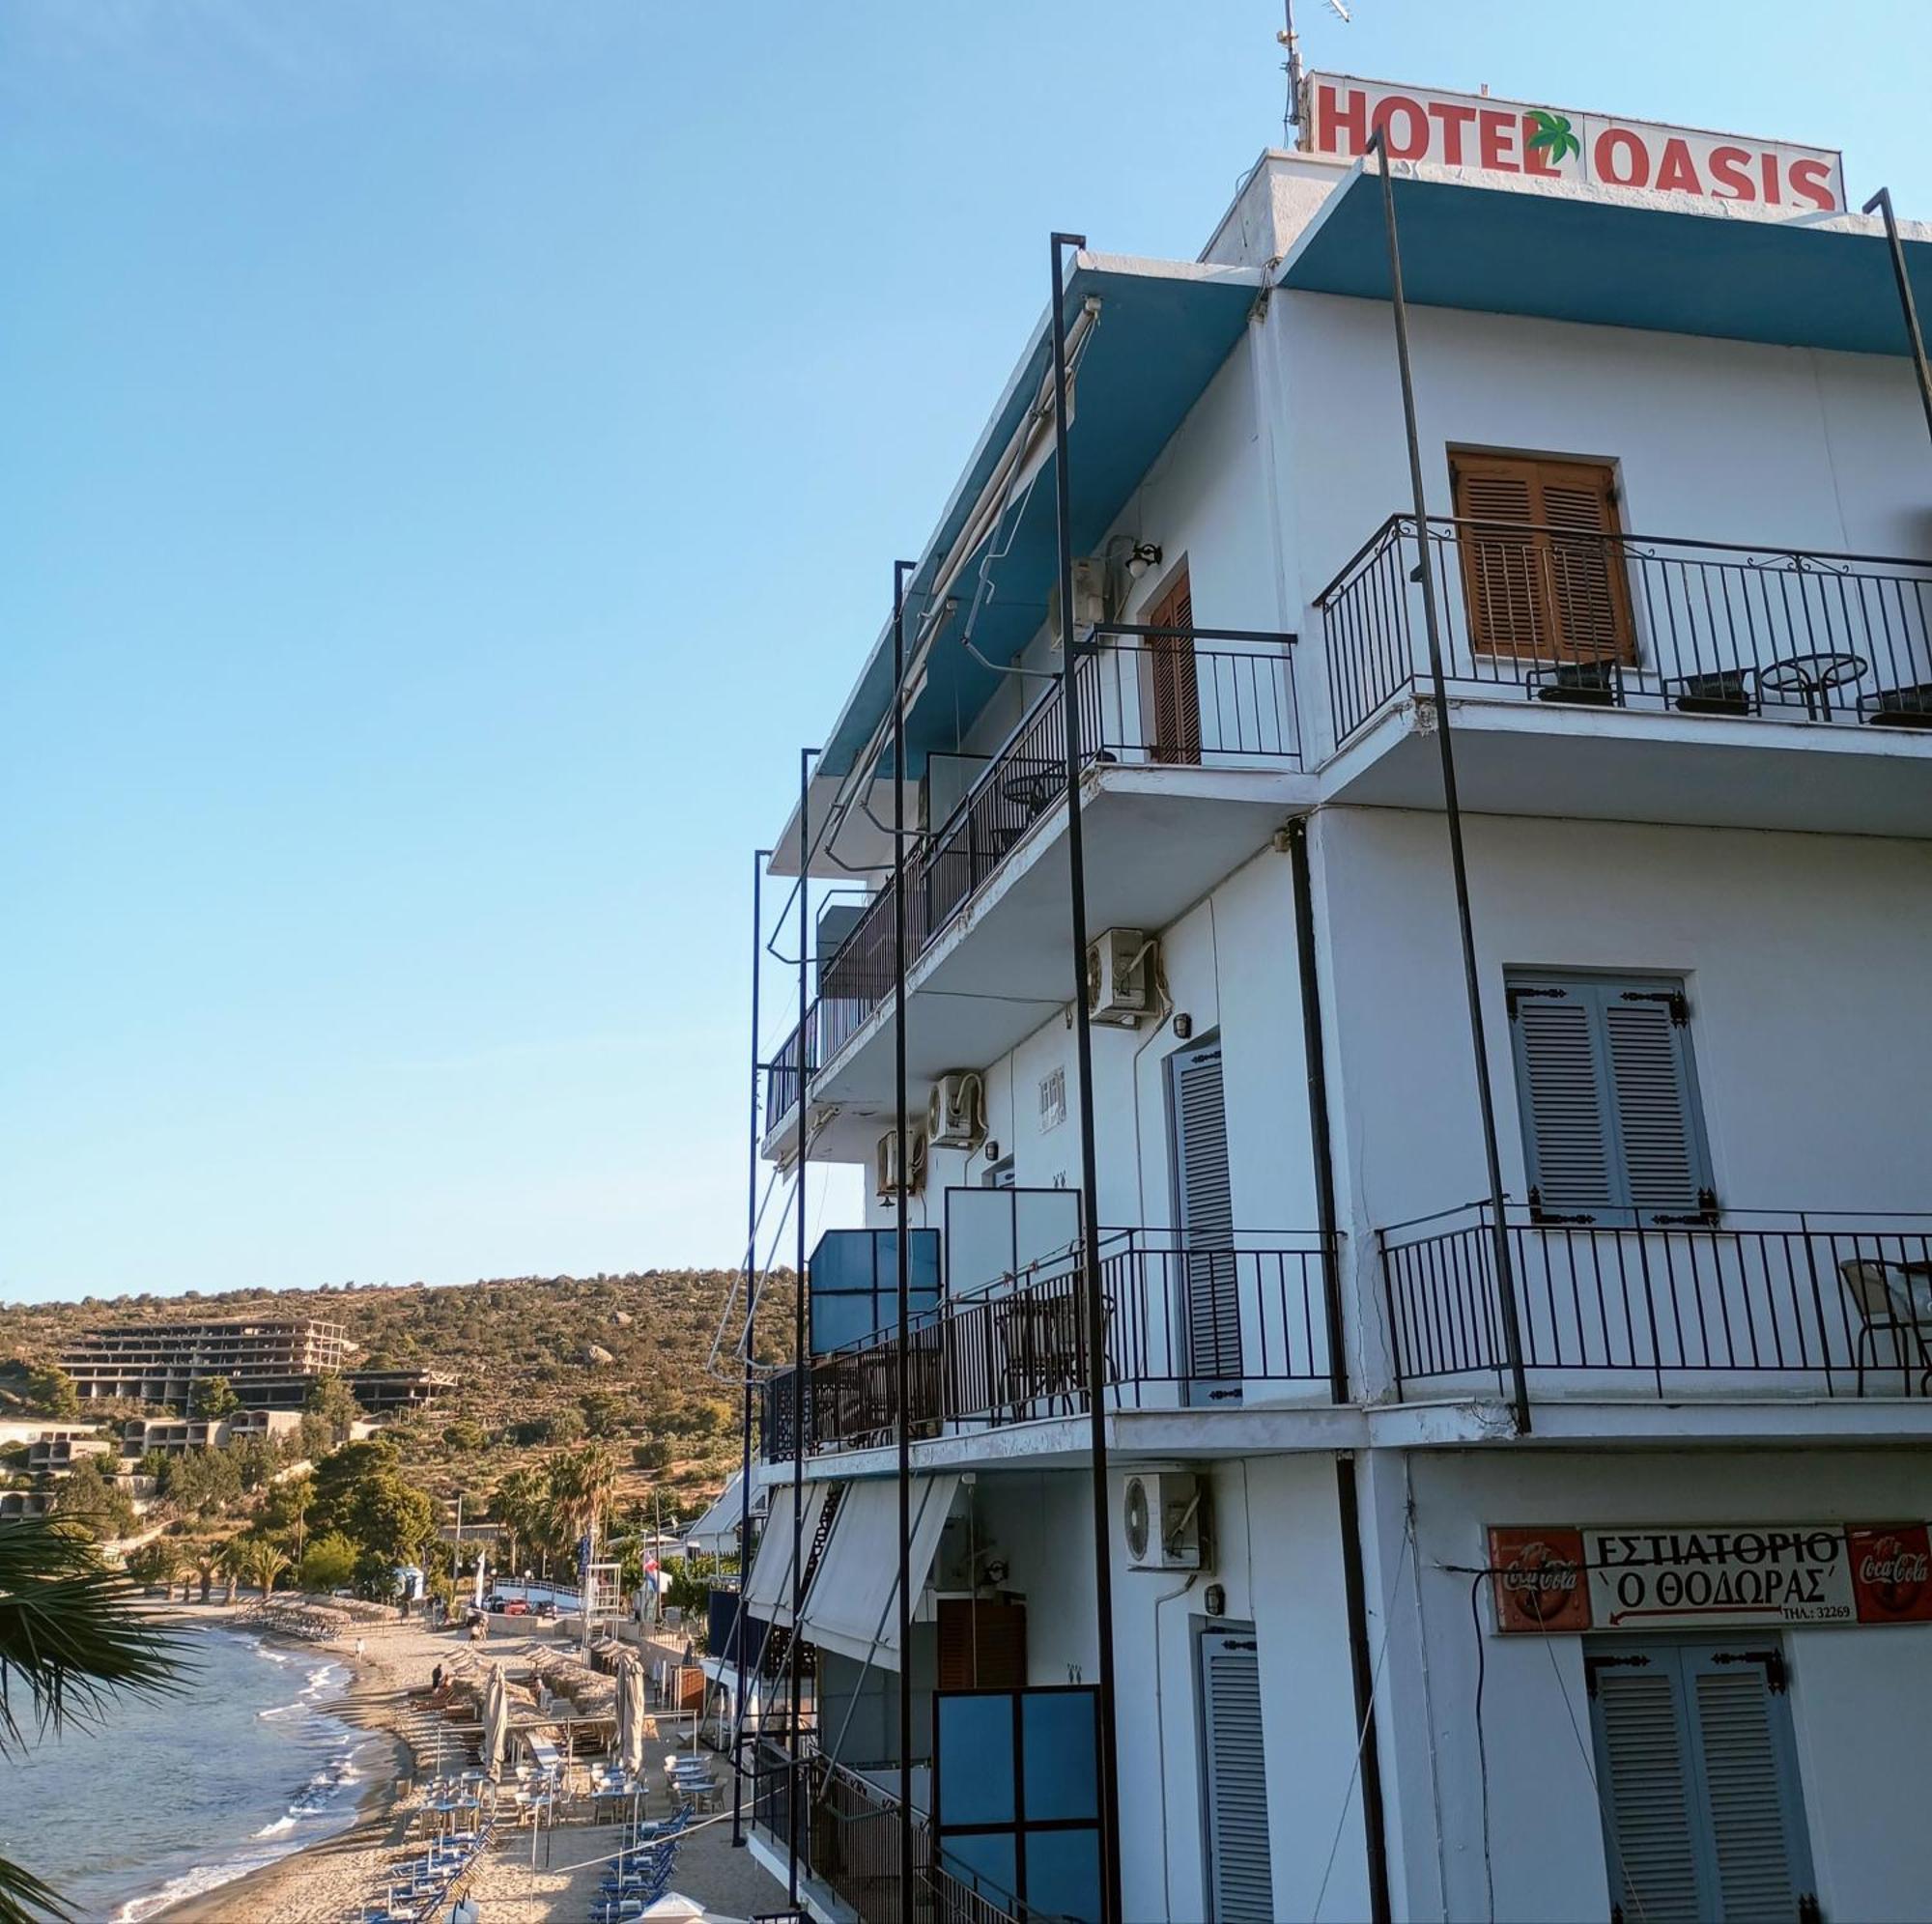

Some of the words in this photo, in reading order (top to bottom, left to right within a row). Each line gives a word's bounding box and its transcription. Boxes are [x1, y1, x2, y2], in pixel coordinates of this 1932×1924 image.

[1319, 85, 1561, 178] HOTEL
[1594, 128, 1835, 211] OASIS
[1597, 1532, 1839, 1567] ΕΣΤΙΑΤΟΡΙΟ
[1860, 1552, 1929, 1585] Coca-Cola
[1816, 1606, 1850, 1619] 32269
